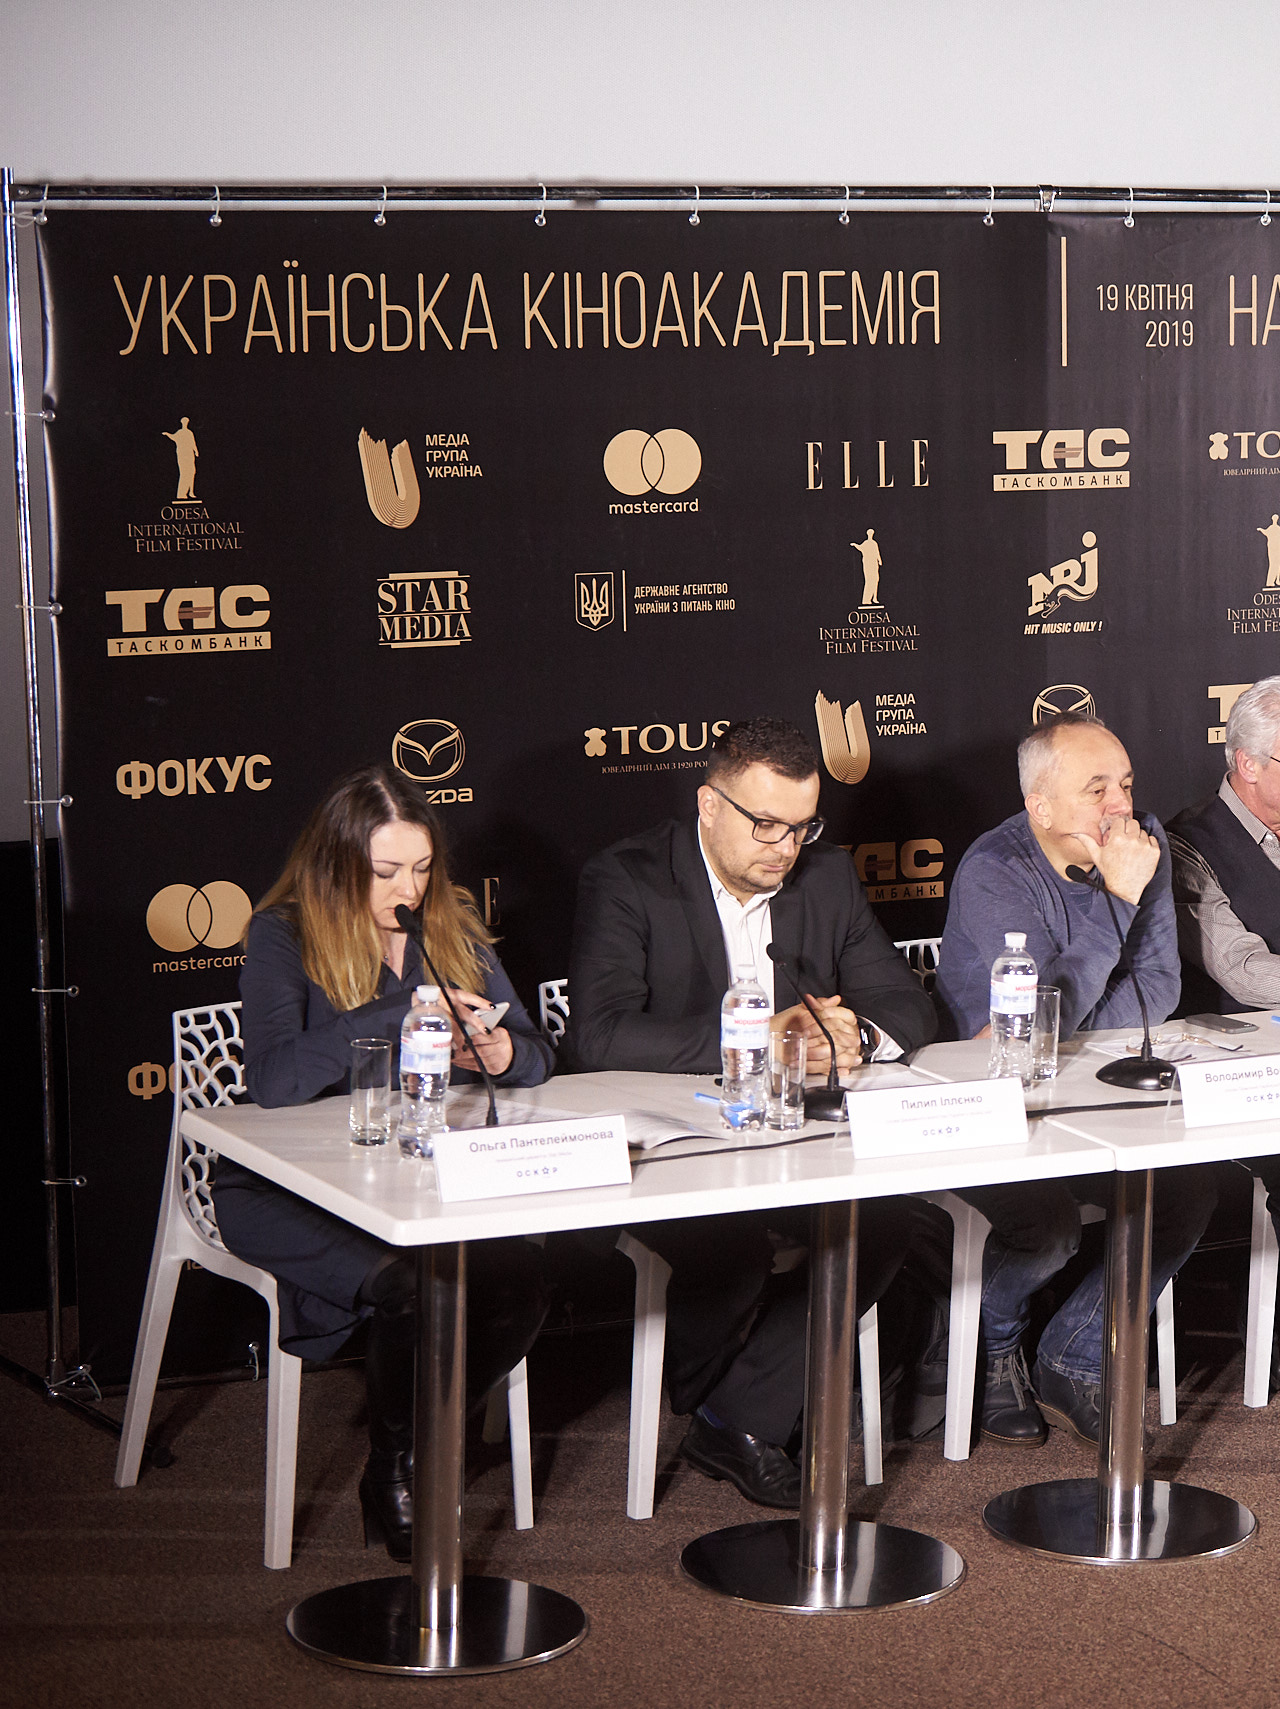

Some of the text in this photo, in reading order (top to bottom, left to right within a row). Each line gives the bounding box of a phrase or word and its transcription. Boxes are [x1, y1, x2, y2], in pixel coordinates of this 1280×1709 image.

[1097, 284, 1193, 311] 19 КВІТНЯ
[114, 260, 940, 356] УКРАЇНСЬКА КІНОАКАДЕМІЯ
[1146, 321, 1193, 347] 2019
[426, 434, 469, 447] МЕДІА
[426, 450, 468, 462] ГРУПА
[992, 428, 1130, 470] ТАС
[426, 463, 482, 478] УКРАЇНА
[806, 440, 928, 489] ELLE
[1002, 475, 1122, 488] ТАСКОМБАНК
[161, 506, 210, 521] ODESA
[609, 498, 698, 514] mastercard
[127, 522, 245, 537] INTERNATIONAL
[135, 537, 243, 553] FILM FESTIVAL
[378, 580, 471, 617] STAR
[634, 583, 728, 599] ДЕРЖАВНЕ АГЕНТСТВО
[105, 585, 270, 633] ТАС
[634, 600, 670, 614] УКРАЇНИ
[681, 600, 713, 612] ПИТАНЬ
[715, 598, 736, 611] КІНО
[848, 611, 891, 625] ODESA
[379, 614, 471, 641] MEDIA
[819, 625, 920, 640] INTERNATIONAL
[1024, 624, 1040, 635] HIT
[1041, 622, 1072, 634] MUSIC
[1233, 621, 1260, 634] FILM
[116, 636, 262, 653] ТАСКОМБАНК
[826, 639, 919, 655] FILM FESTIVAL
[876, 694, 915, 707] МЕДІА
[876, 709, 914, 721] ГРУПА
[876, 721, 927, 736] УКРАЇНА
[694, 760, 708, 769] РО
[117, 754, 272, 799] ФОКУС
[425, 787, 474, 805] zda
[837, 838, 944, 882] АС
[875, 884, 937, 900] МБАНК
[1205, 1069, 1264, 1083] Володимир
[901, 1098, 937, 1110] Пилип
[469, 1129, 614, 1153] Ольга Пантелеймонова
